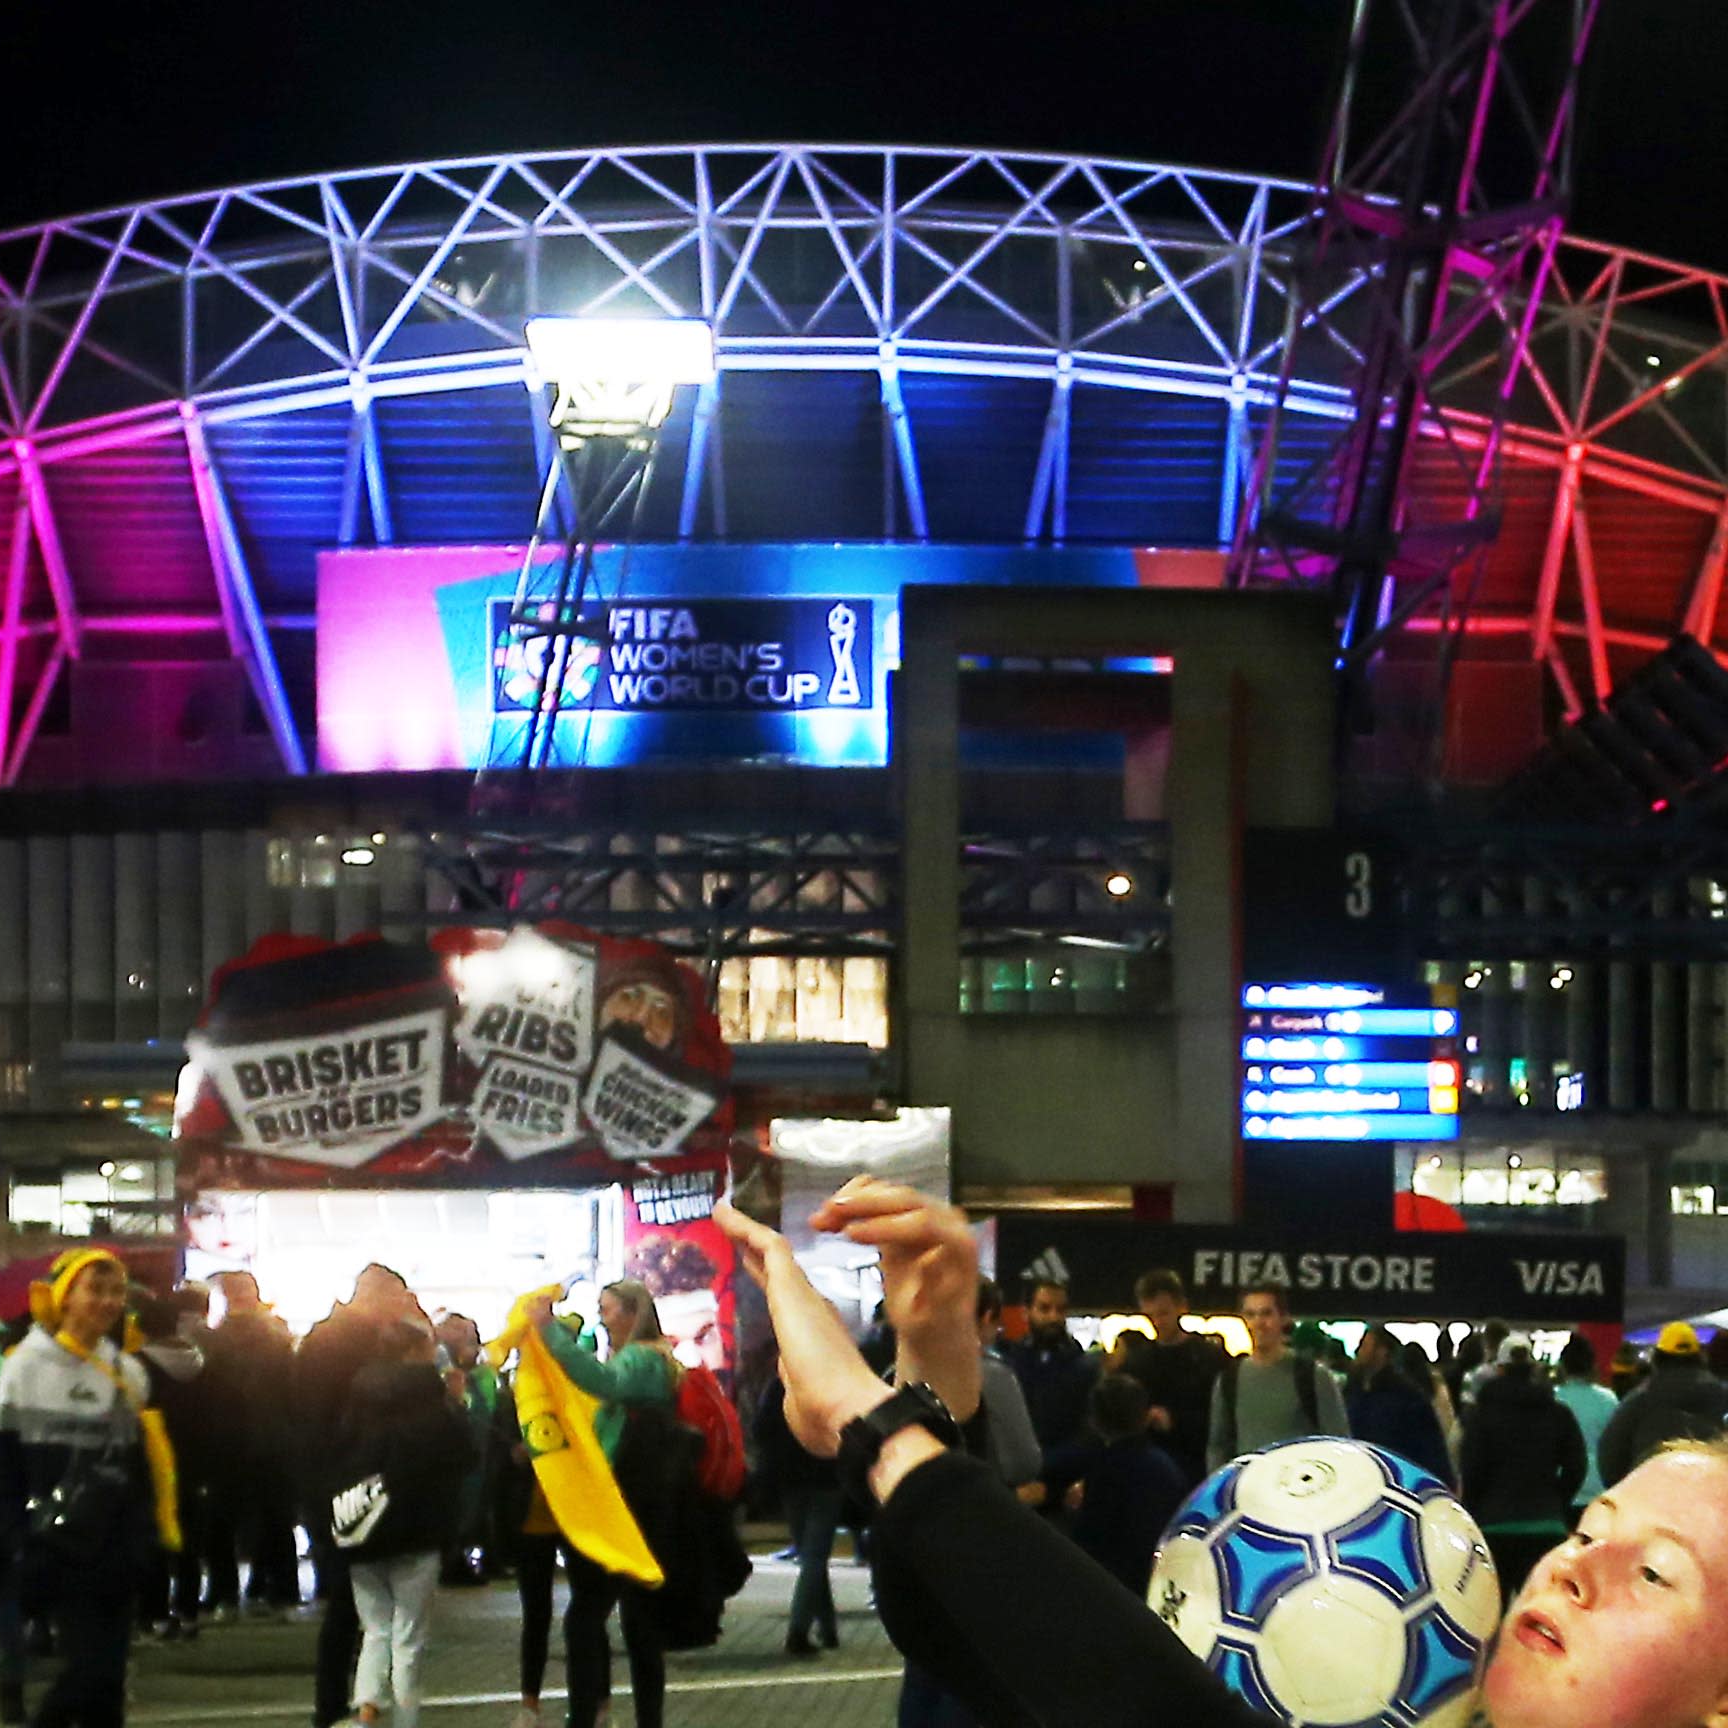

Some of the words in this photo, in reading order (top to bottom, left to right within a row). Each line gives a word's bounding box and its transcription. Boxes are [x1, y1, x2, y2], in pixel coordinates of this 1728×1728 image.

[609, 607, 698, 640] FIFA
[610, 642, 783, 673] WOMEN'S
[609, 673, 739, 705] WORLD
[745, 672, 821, 704] CUP
[1345, 852, 1371, 918] 3
[473, 1002, 577, 1063] RIBS
[232, 1029, 429, 1100] BRISKET
[491, 1065, 572, 1106] LOADED
[253, 1086, 422, 1143] BURGERS
[480, 1089, 565, 1134] FRIES
[593, 1093, 668, 1149] WINGS
[1193, 1250, 1291, 1287] FIFA
[1297, 1252, 1435, 1291] STORE
[1515, 1259, 1604, 1296] VISA
[332, 1473, 384, 1530] NIKE
